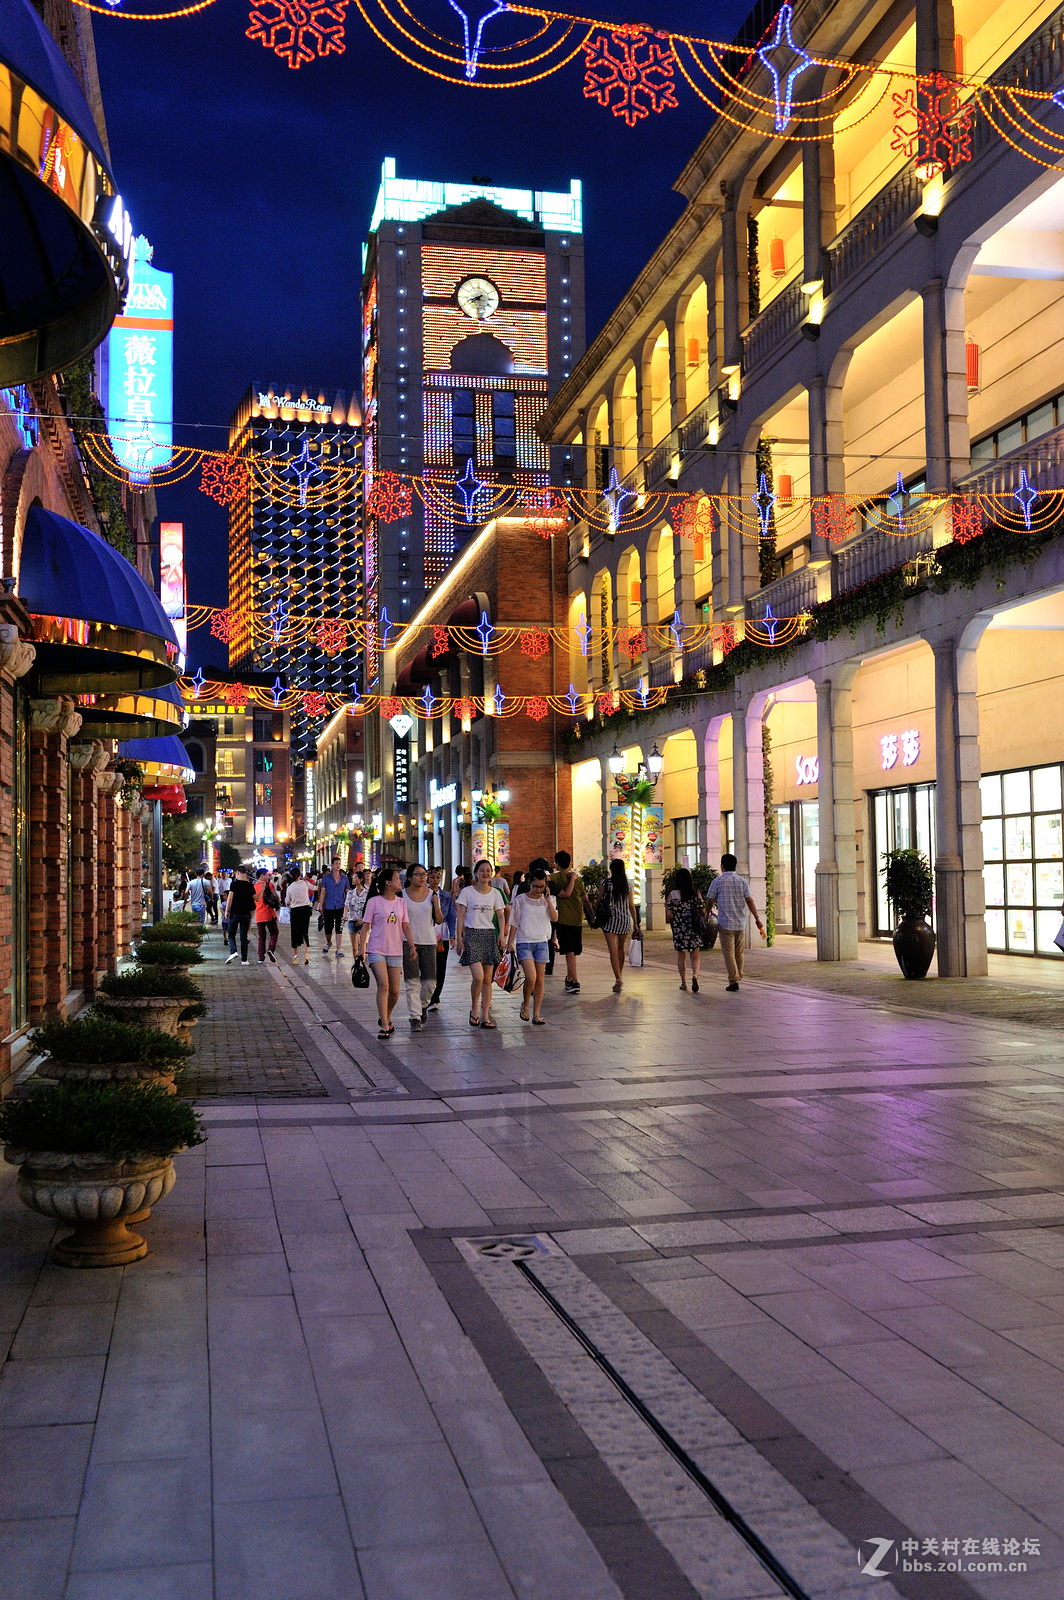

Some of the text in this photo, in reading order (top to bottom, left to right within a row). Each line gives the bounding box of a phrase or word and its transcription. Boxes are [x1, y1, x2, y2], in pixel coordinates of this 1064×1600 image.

[126, 296, 168, 310] UEEN
[124, 334, 157, 461] 薇拉皇后
[272, 396, 332, 416] Wanda Reign
[880, 729, 920, 770] 莎莎
